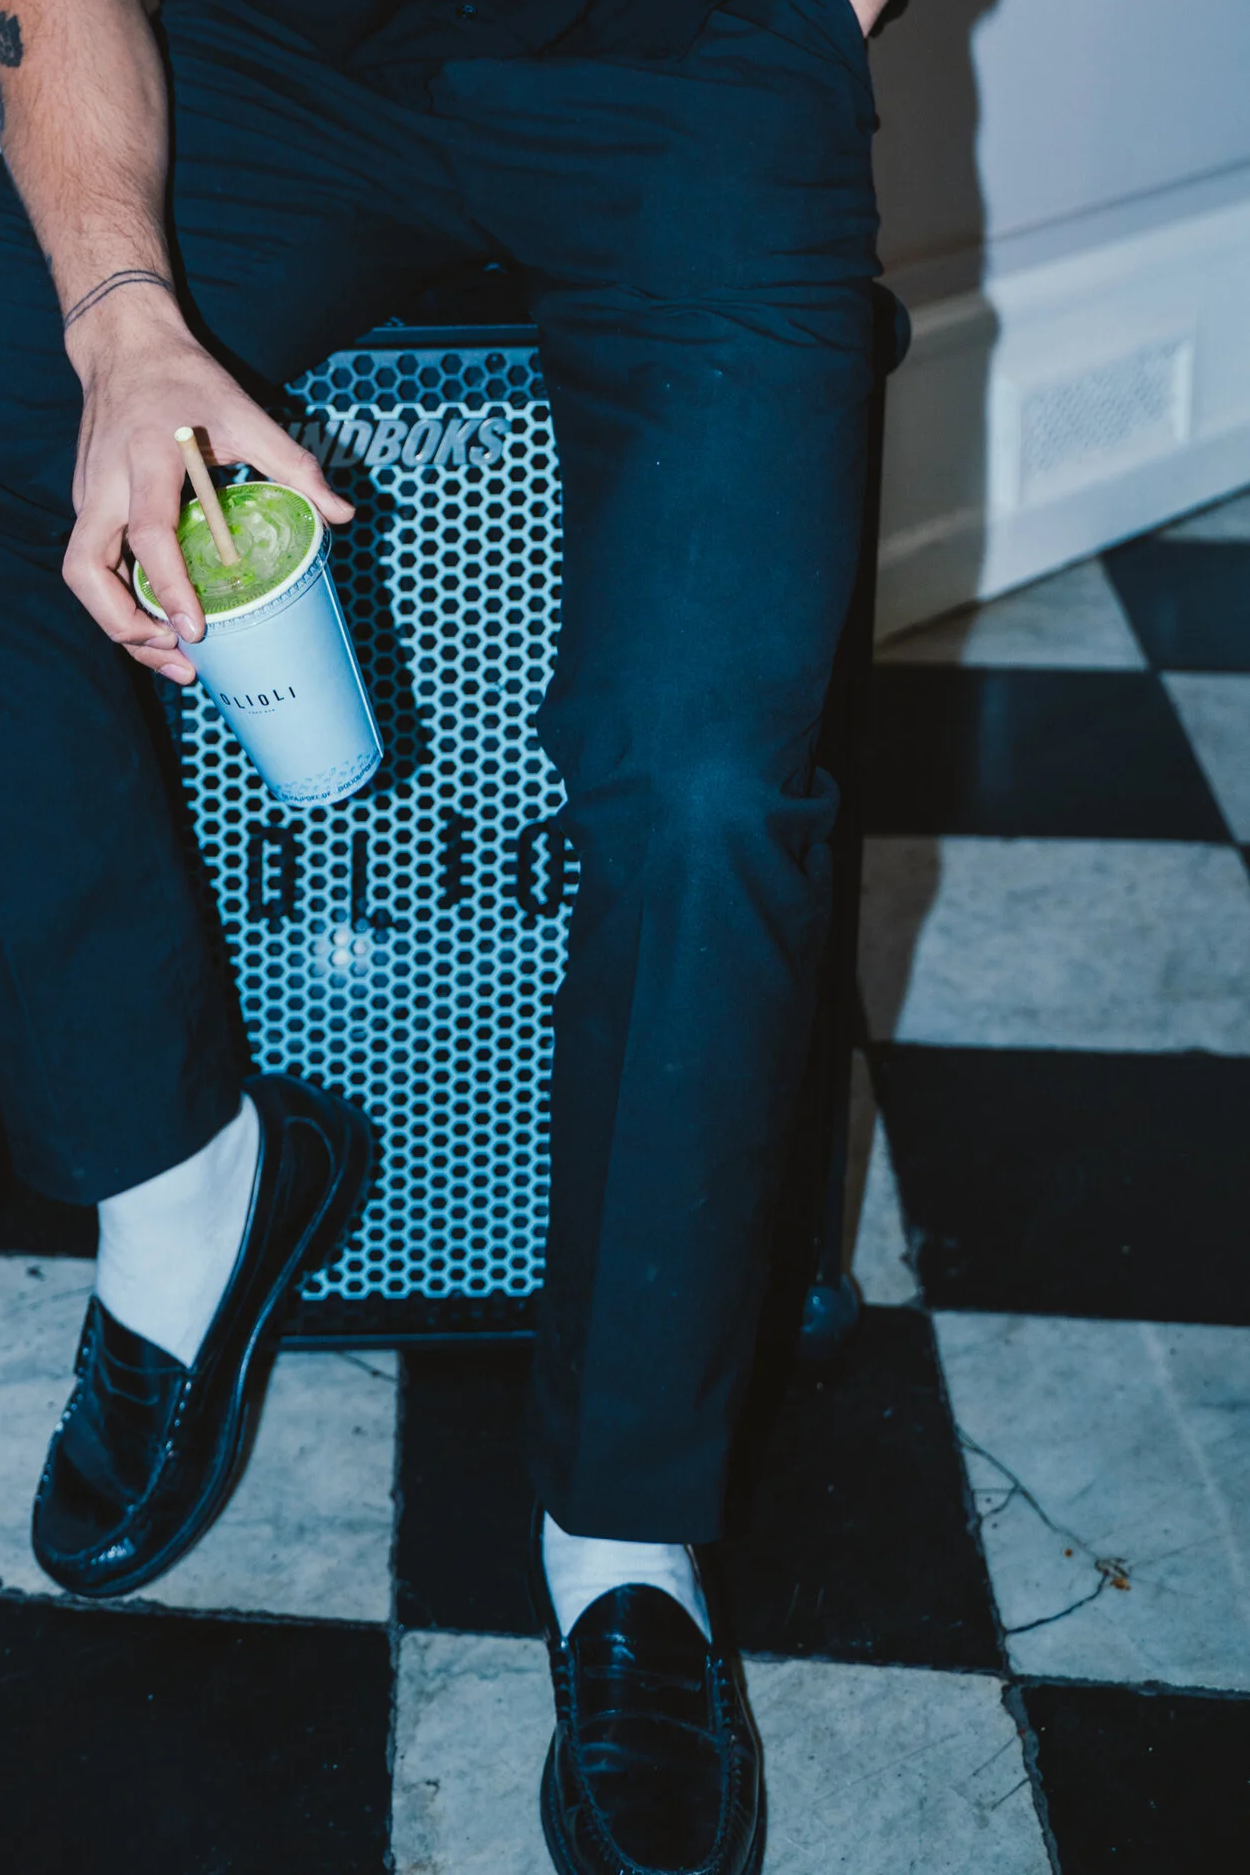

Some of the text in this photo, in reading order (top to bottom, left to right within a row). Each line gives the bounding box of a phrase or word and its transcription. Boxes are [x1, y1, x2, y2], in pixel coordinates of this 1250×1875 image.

[280, 416, 512, 468] NDBOKS
[219, 686, 296, 709] OLIOLI
[249, 815, 568, 929] OLIO
